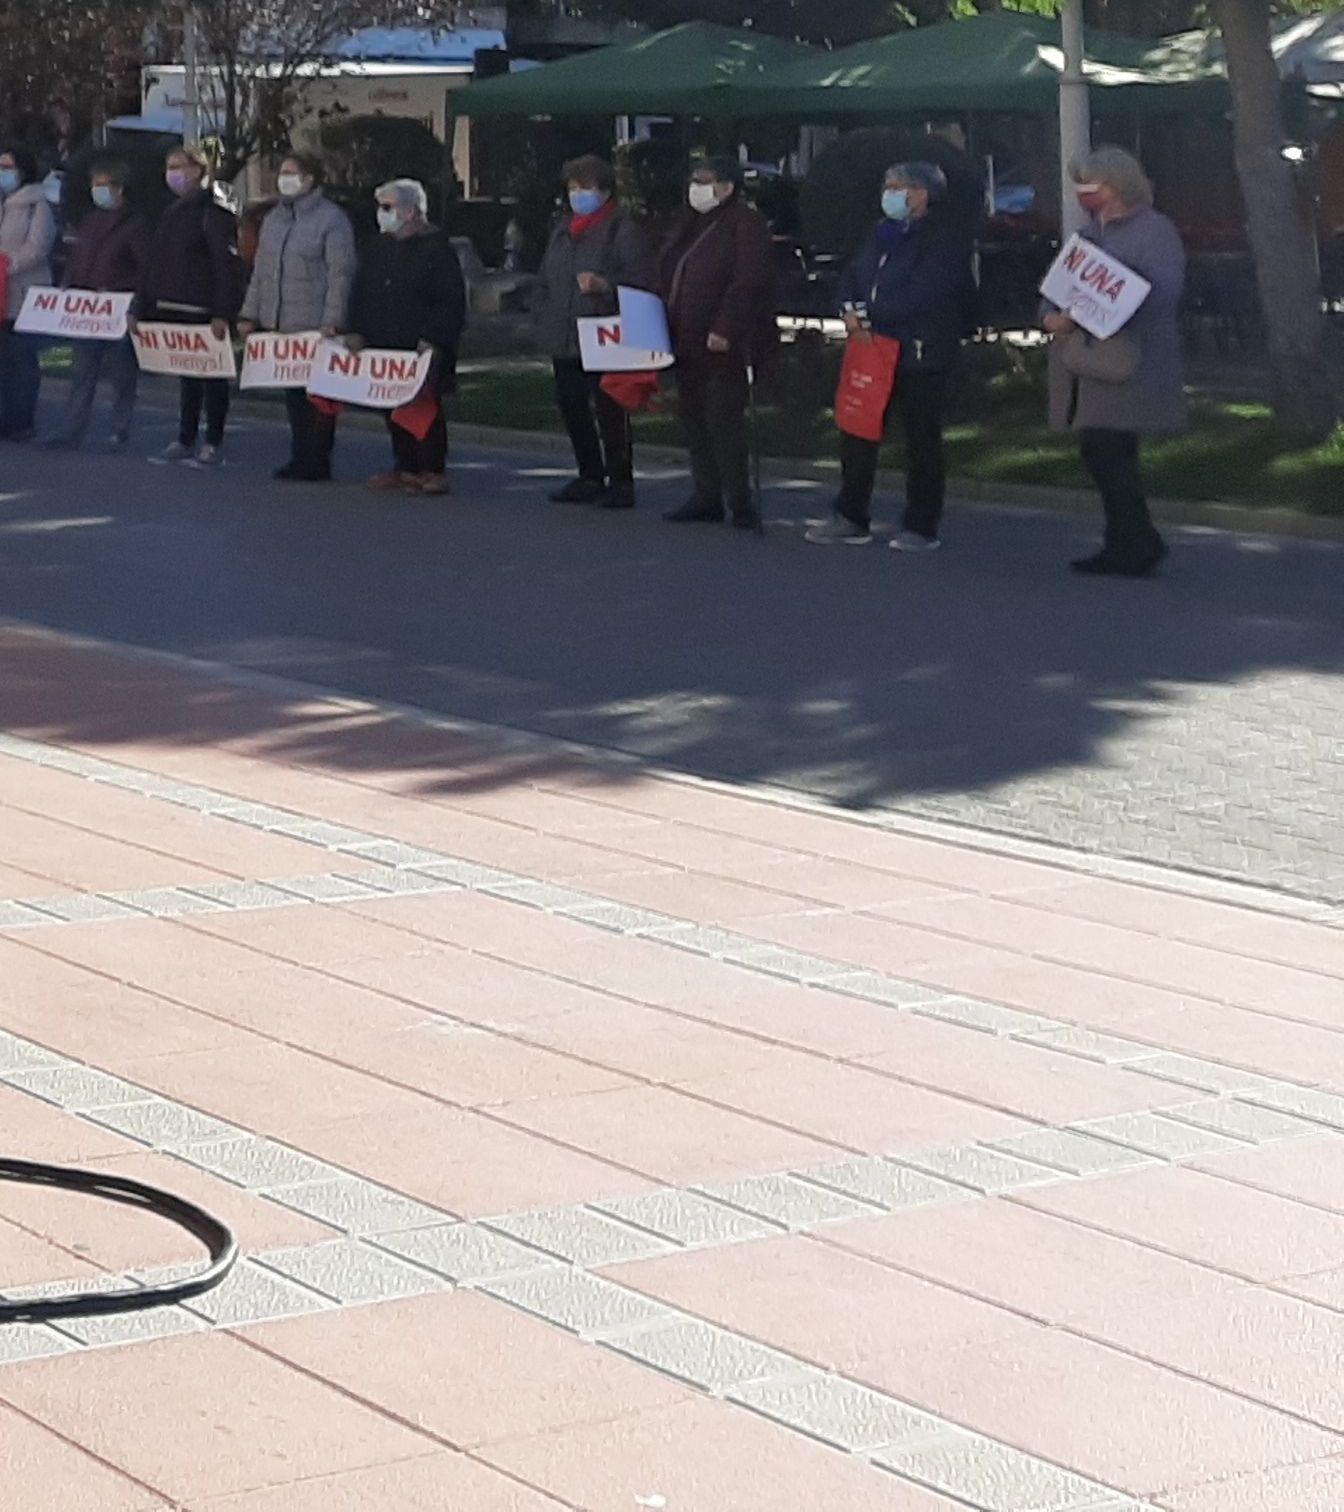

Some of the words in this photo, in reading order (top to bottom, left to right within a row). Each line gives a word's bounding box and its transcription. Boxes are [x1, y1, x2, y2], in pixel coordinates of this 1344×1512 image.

[1079, 259, 1126, 304] UNA
[33, 293, 59, 310] NI
[63, 294, 113, 317] UNA
[136, 331, 160, 350] NI
[162, 330, 209, 353] UNA
[247, 341, 265, 360] NI
[328, 352, 362, 377] NI
